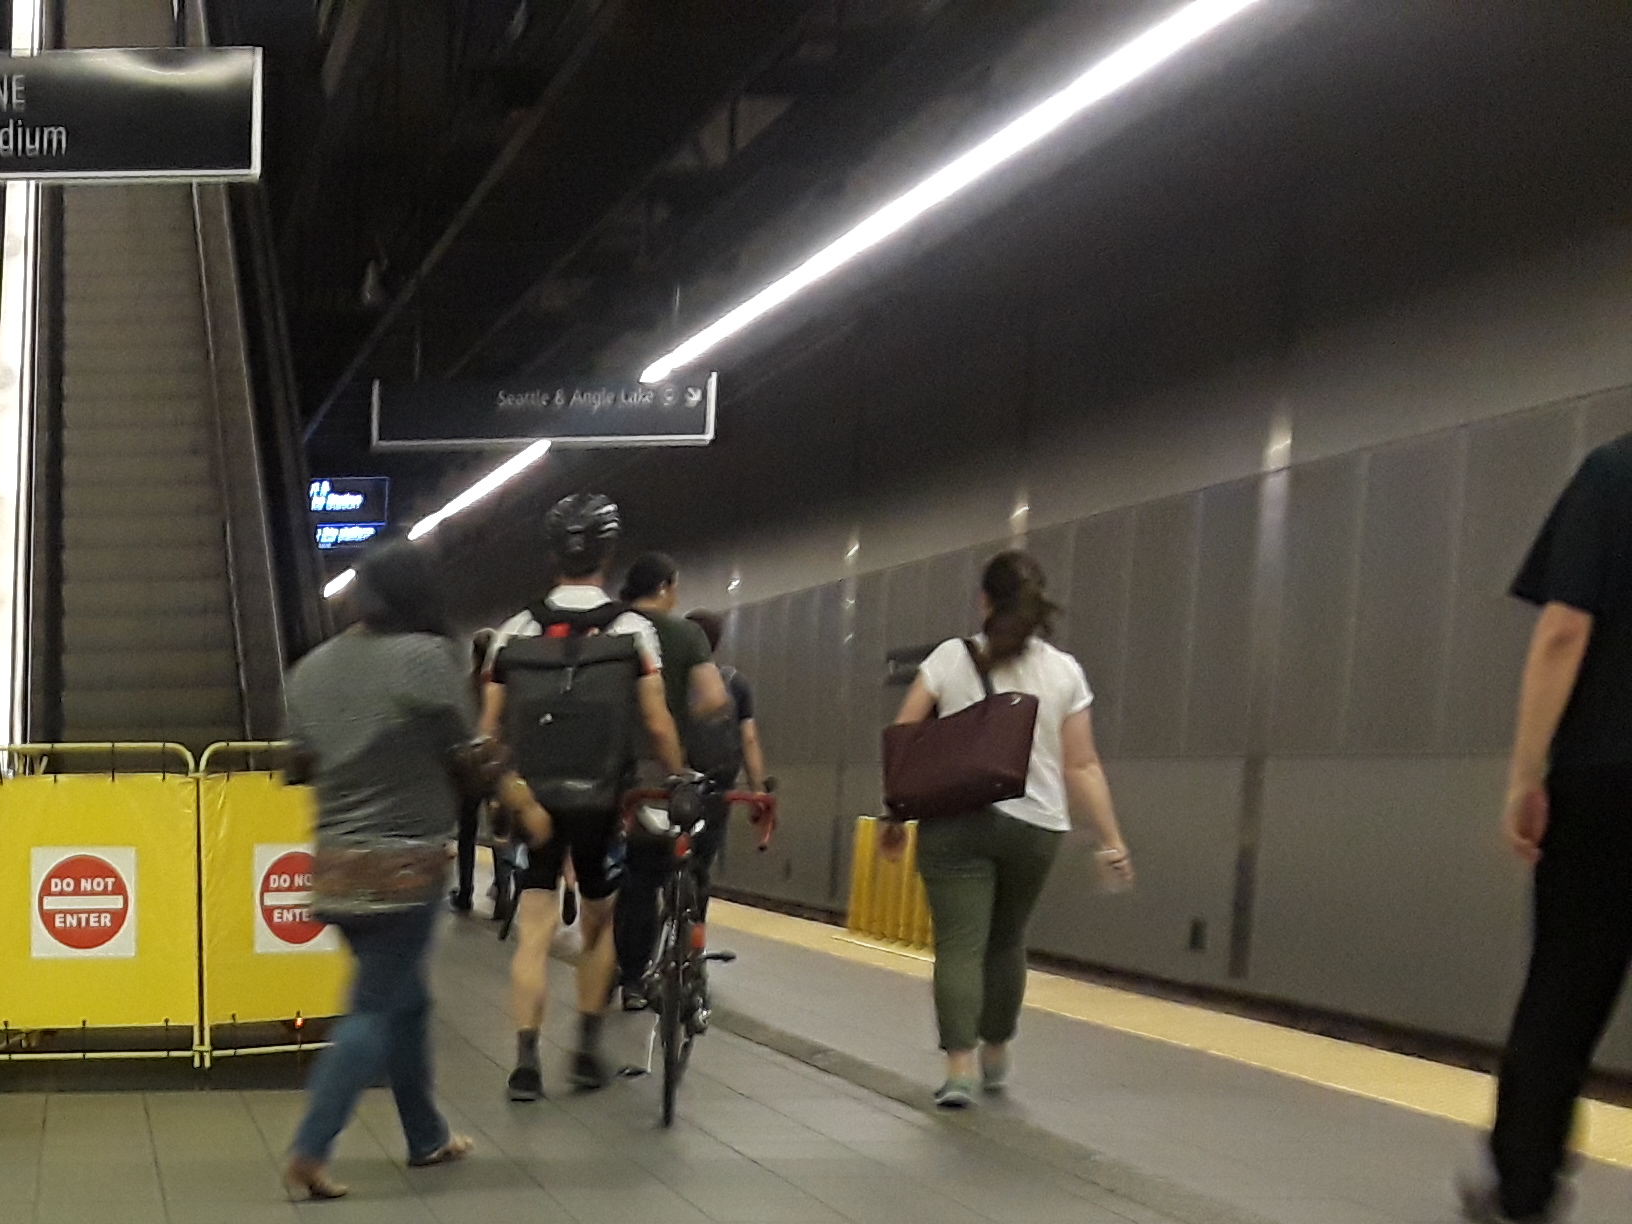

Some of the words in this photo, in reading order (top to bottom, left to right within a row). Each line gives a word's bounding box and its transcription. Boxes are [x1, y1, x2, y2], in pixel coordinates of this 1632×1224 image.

[50, 877, 75, 893] DO
[80, 876, 116, 893] NOT
[269, 873, 291, 889] DO
[294, 872, 314, 888] NO
[54, 912, 112, 929] ENTER
[273, 908, 312, 923] ENTE
